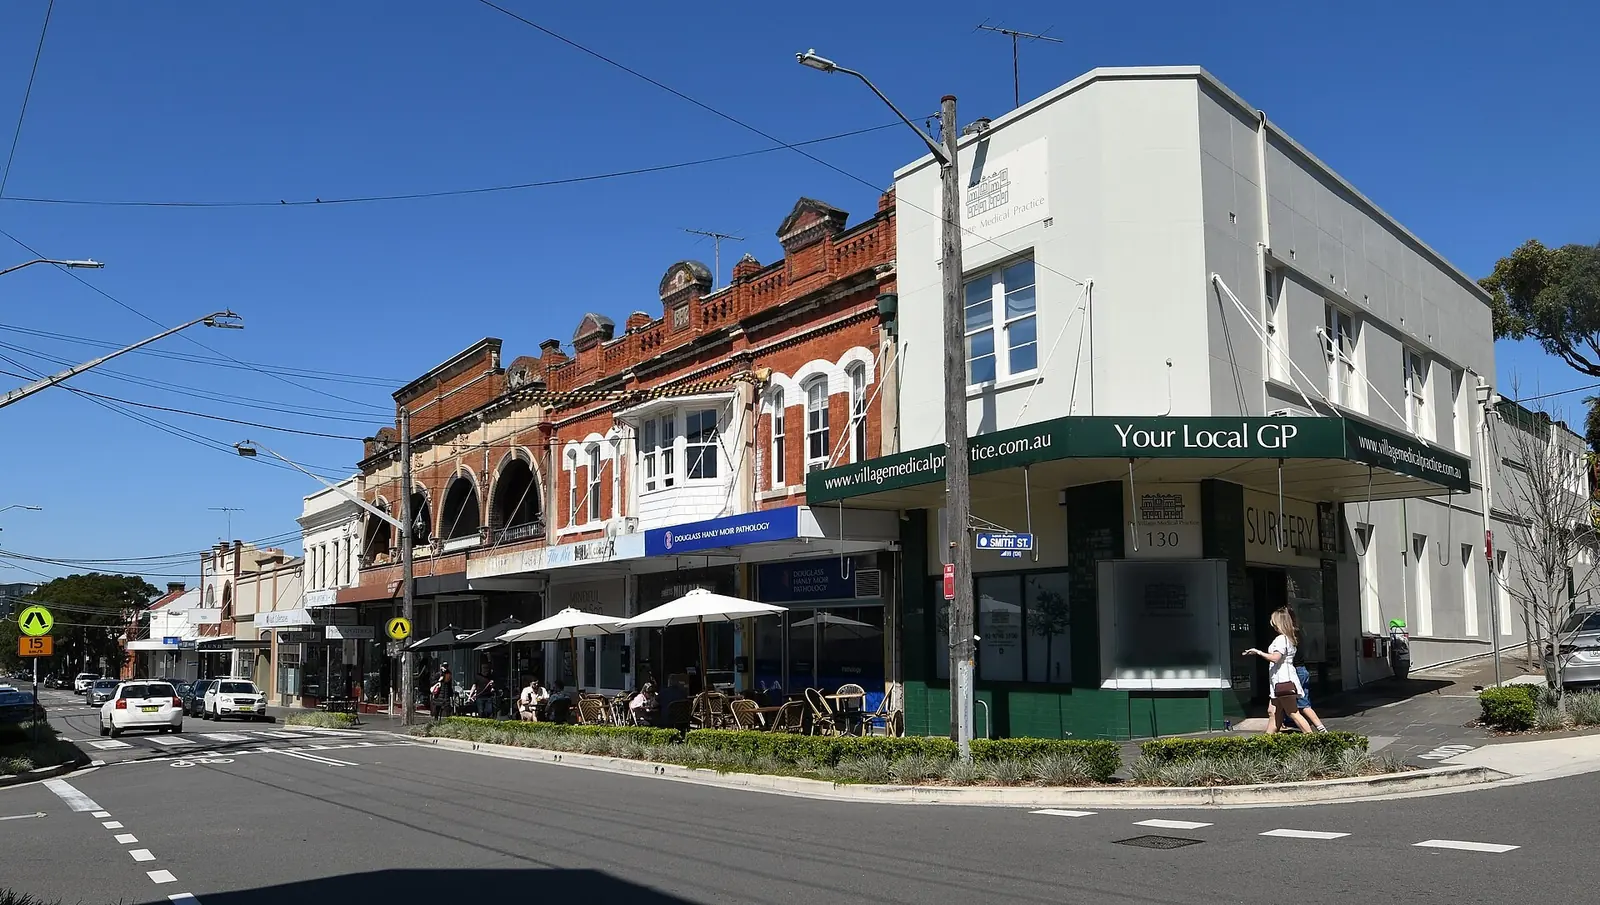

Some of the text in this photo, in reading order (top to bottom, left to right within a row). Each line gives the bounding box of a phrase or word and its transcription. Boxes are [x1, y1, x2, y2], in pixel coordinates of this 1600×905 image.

[980, 212, 1010, 229] Medical
[1013, 196, 1045, 216] Practice
[1113, 422, 1298, 448] Your Local GP
[824, 433, 1051, 490] www.villagemedicalprtice.com.au
[1358, 435, 1462, 479] www.villagemedicalpractice.com.au
[674, 522, 770, 543] DOUGLASS HANLY MOIR PATHOLOGY
[1246, 506, 1315, 550] SURGERY
[989, 537, 1029, 548] SMITH ST.
[1146, 531, 1179, 547] 130
[793, 568, 824, 578] DOUGLASS
[793, 576, 829, 585] HANLY MOIR
[793, 584, 828, 593] PATHOLOGY
[29, 638, 43, 649] 15
[841, 666, 862, 674] Pathology
